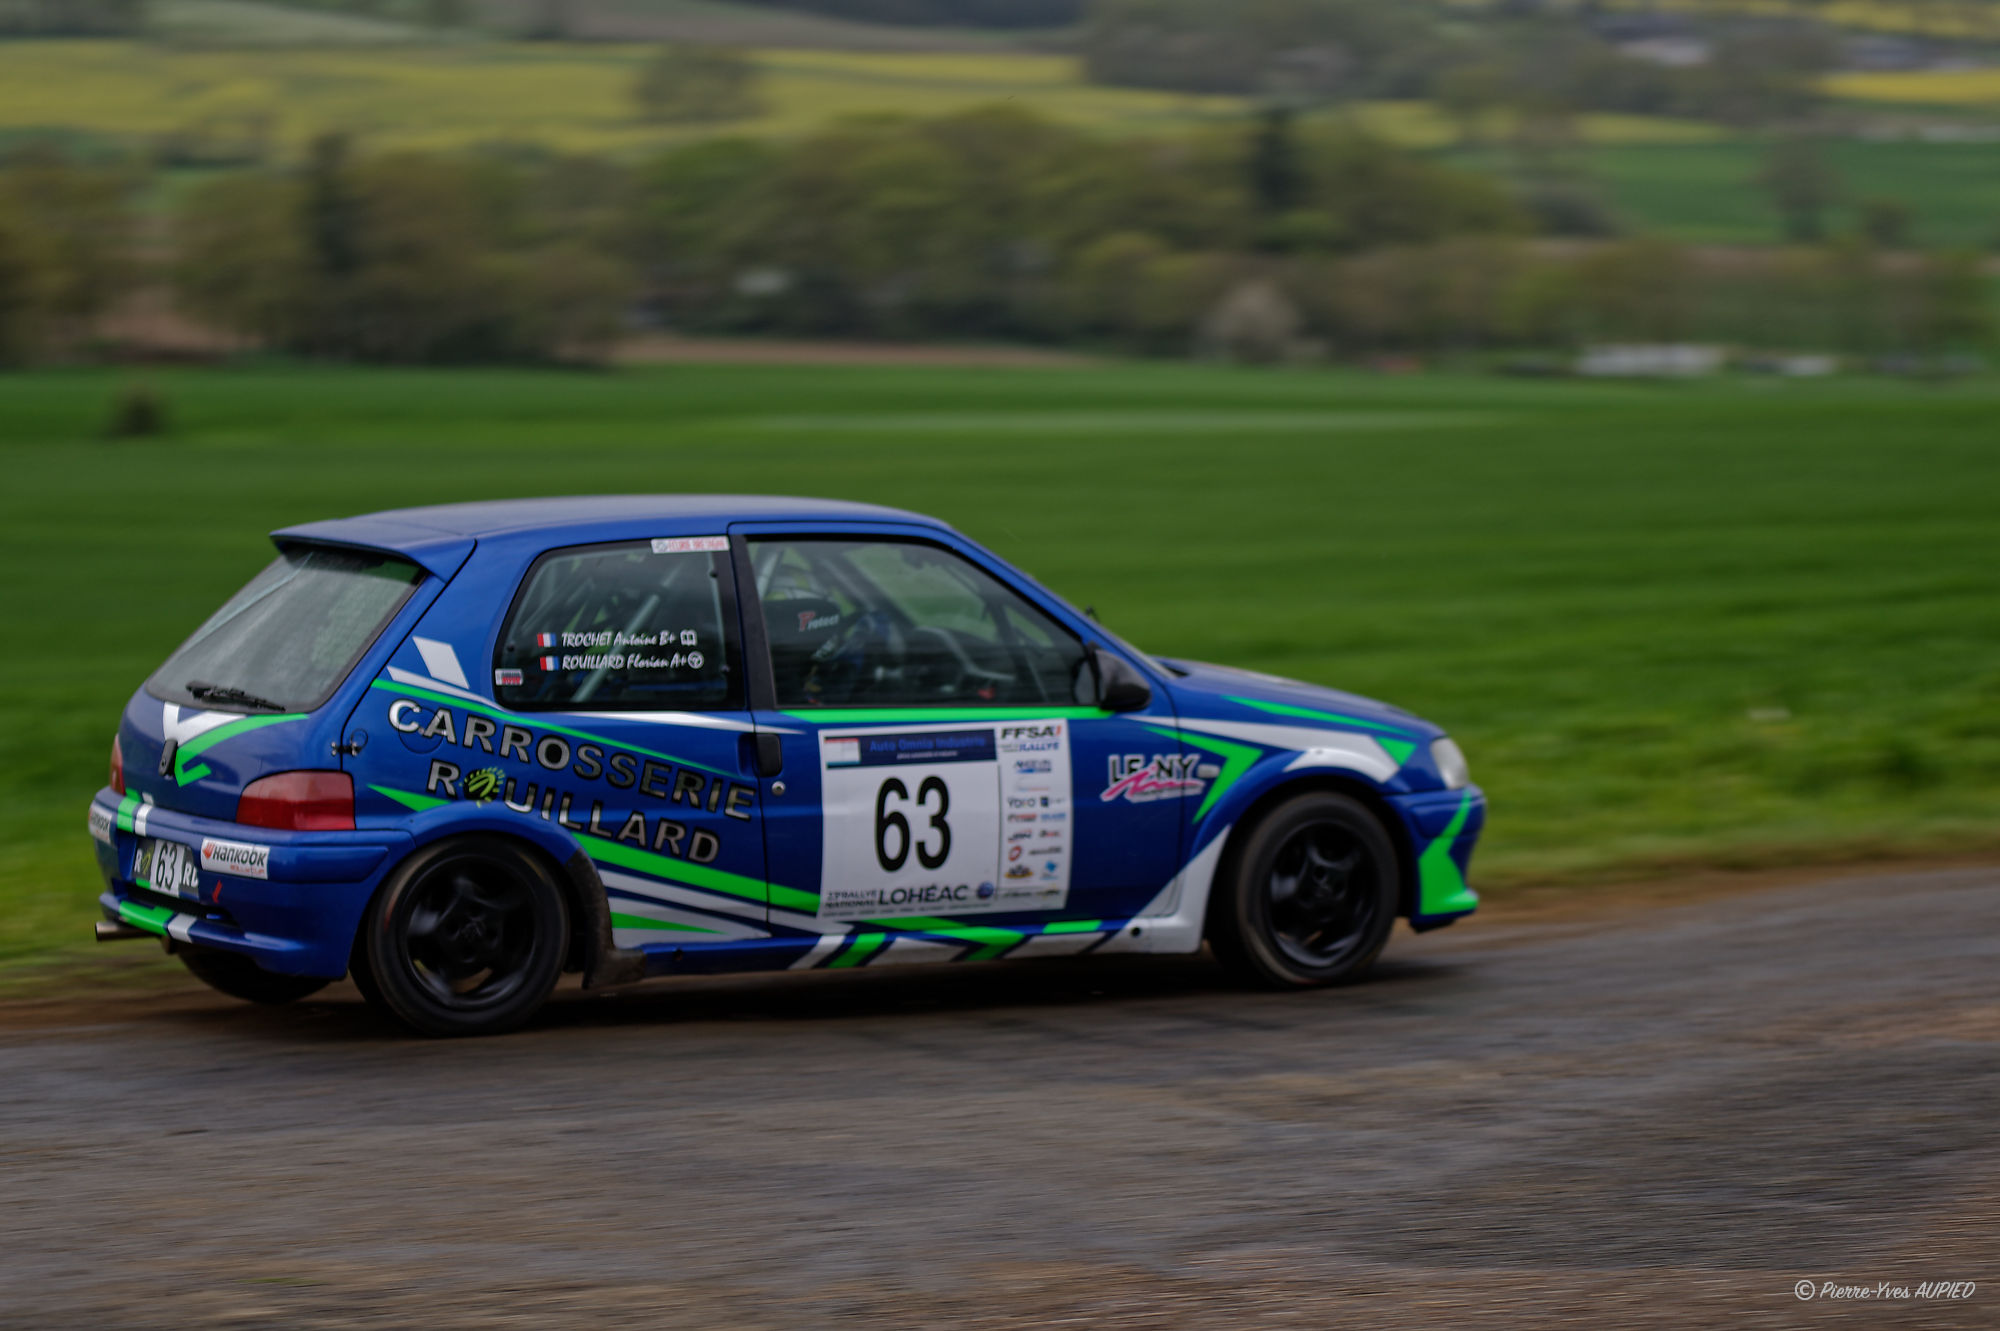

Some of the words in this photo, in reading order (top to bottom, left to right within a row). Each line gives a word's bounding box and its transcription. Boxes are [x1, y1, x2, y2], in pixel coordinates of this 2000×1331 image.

[561, 631, 612, 648] TROCHET
[614, 630, 657, 647] Antoine
[659, 629, 677, 646] B+
[562, 653, 624, 671] ROUILLARD
[627, 652, 669, 669] Florian
[870, 740, 895, 752] Auto
[897, 738, 933, 750] Omnia
[388, 698, 756, 820] CARROSSERIE
[874, 775, 951, 872] 63
[156, 842, 177, 891] 63
[878, 885, 969, 905] LOHÉAC
